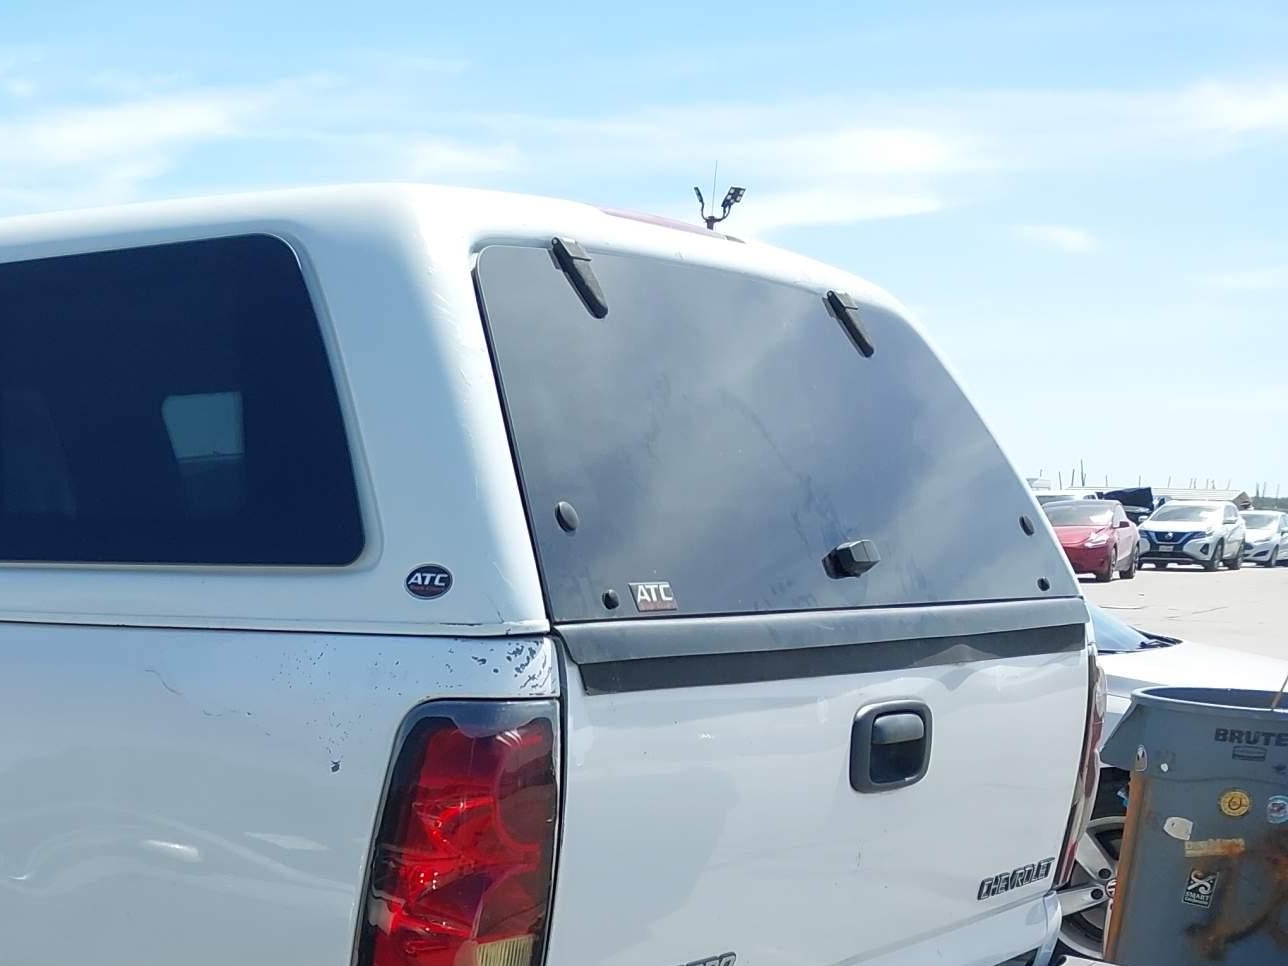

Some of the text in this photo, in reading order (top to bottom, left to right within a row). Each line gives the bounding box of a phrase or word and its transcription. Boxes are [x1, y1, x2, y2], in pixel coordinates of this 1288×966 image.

[407, 572, 449, 586] ATC
[637, 584, 673, 603] ATC
[1214, 727, 1288, 747] BRUTE
[977, 857, 1055, 901] CHEVROLET
